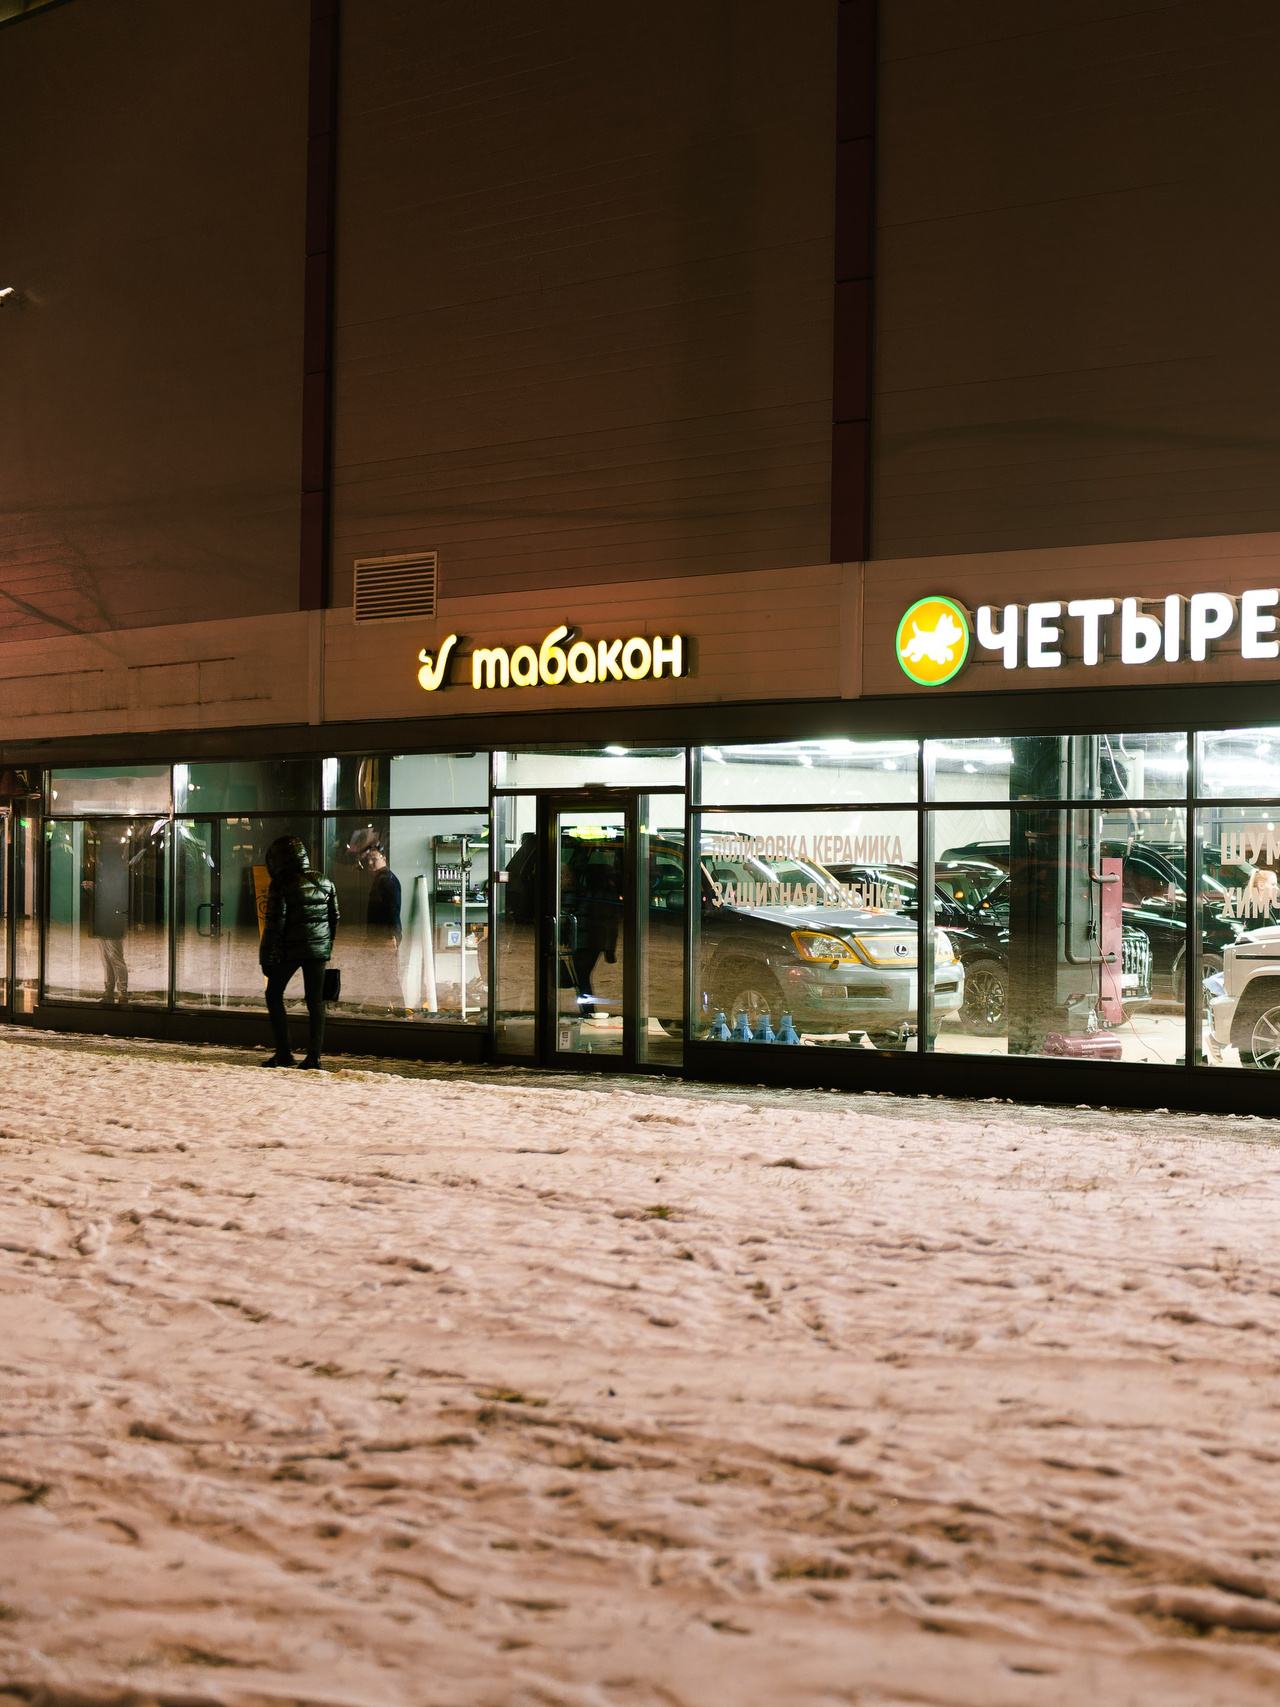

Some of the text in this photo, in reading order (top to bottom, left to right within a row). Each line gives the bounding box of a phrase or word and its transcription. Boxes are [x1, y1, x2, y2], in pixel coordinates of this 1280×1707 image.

[472, 624, 684, 690] табакон
[711, 834, 904, 863] ПОЛИРОВКА КЕРАМИКА
[711, 882, 819, 909] ЗАЩИТНАЯ
